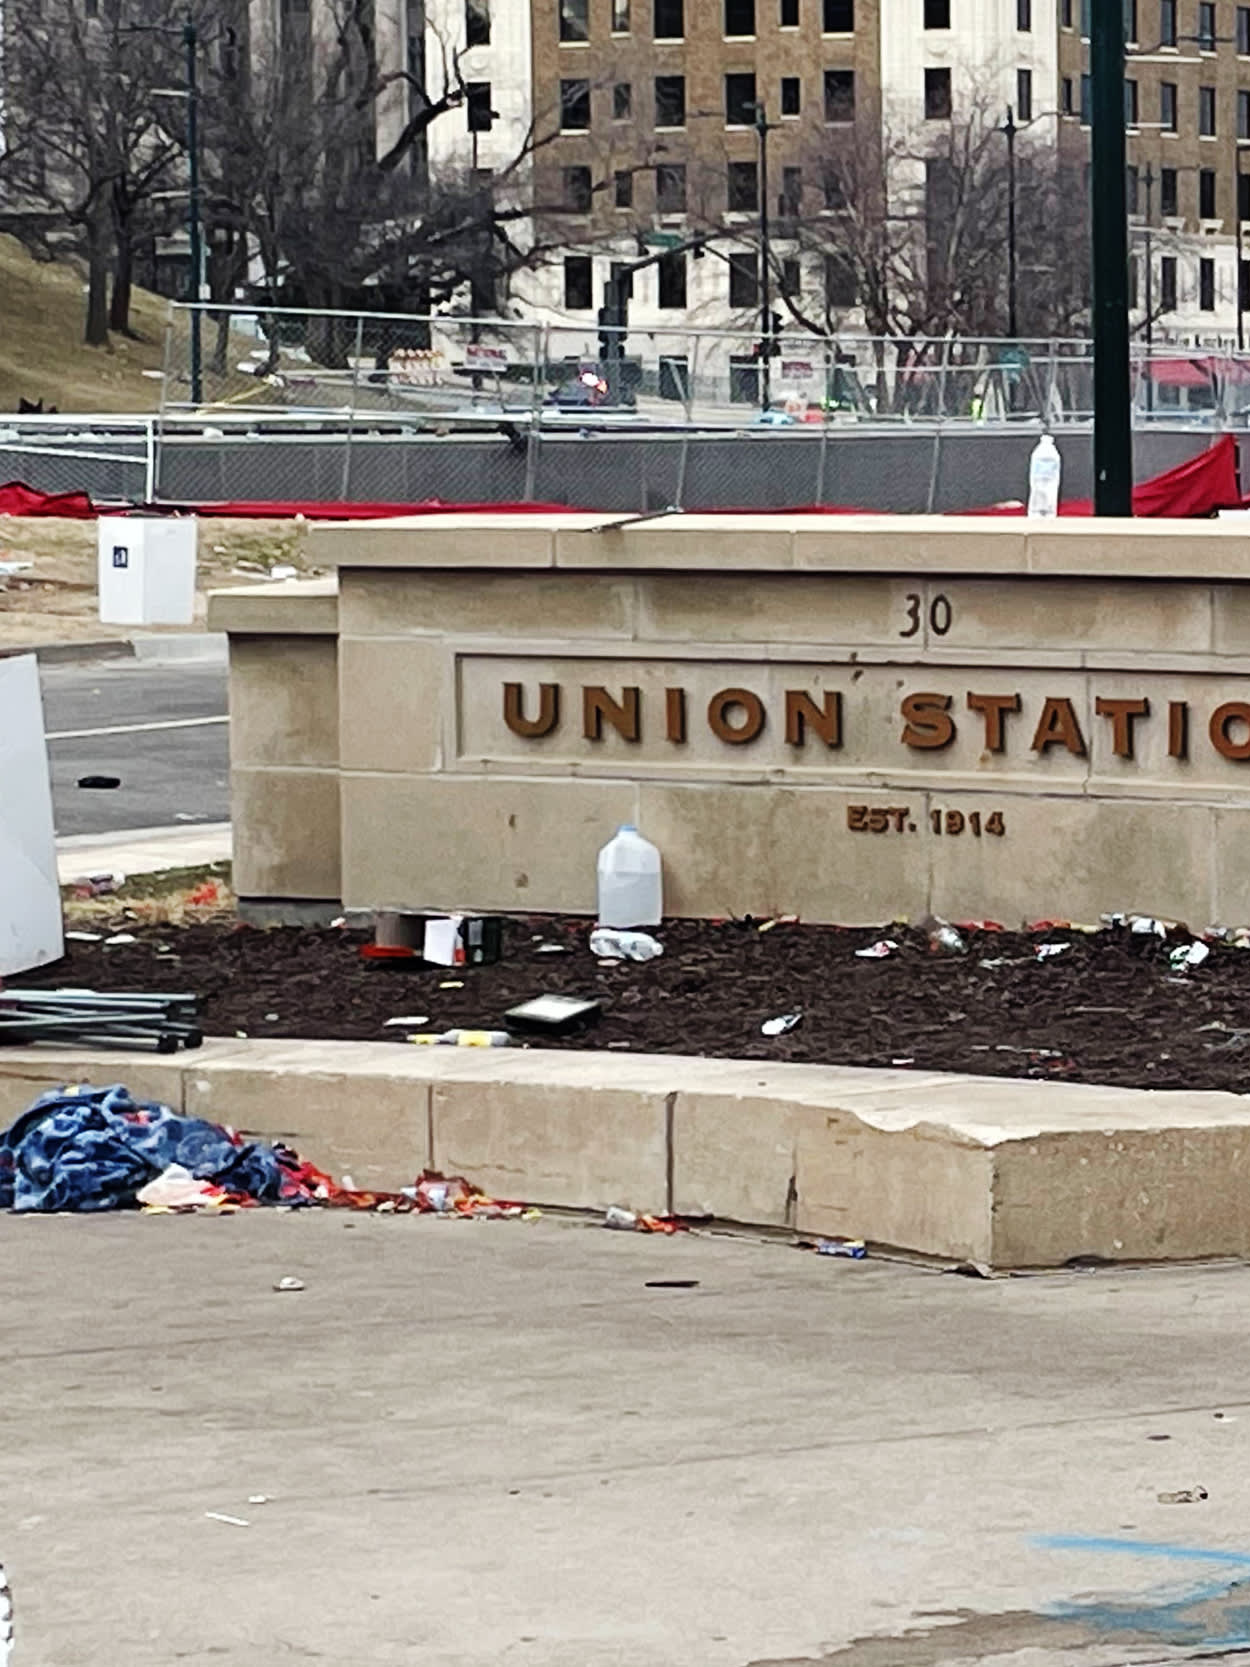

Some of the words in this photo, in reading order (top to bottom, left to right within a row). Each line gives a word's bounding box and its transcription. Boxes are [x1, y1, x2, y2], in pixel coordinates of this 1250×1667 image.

[899, 593, 952, 638] 30
[502, 682, 843, 748] UNION
[847, 805, 917, 833] EST.
[930, 808, 1005, 837] 1914
